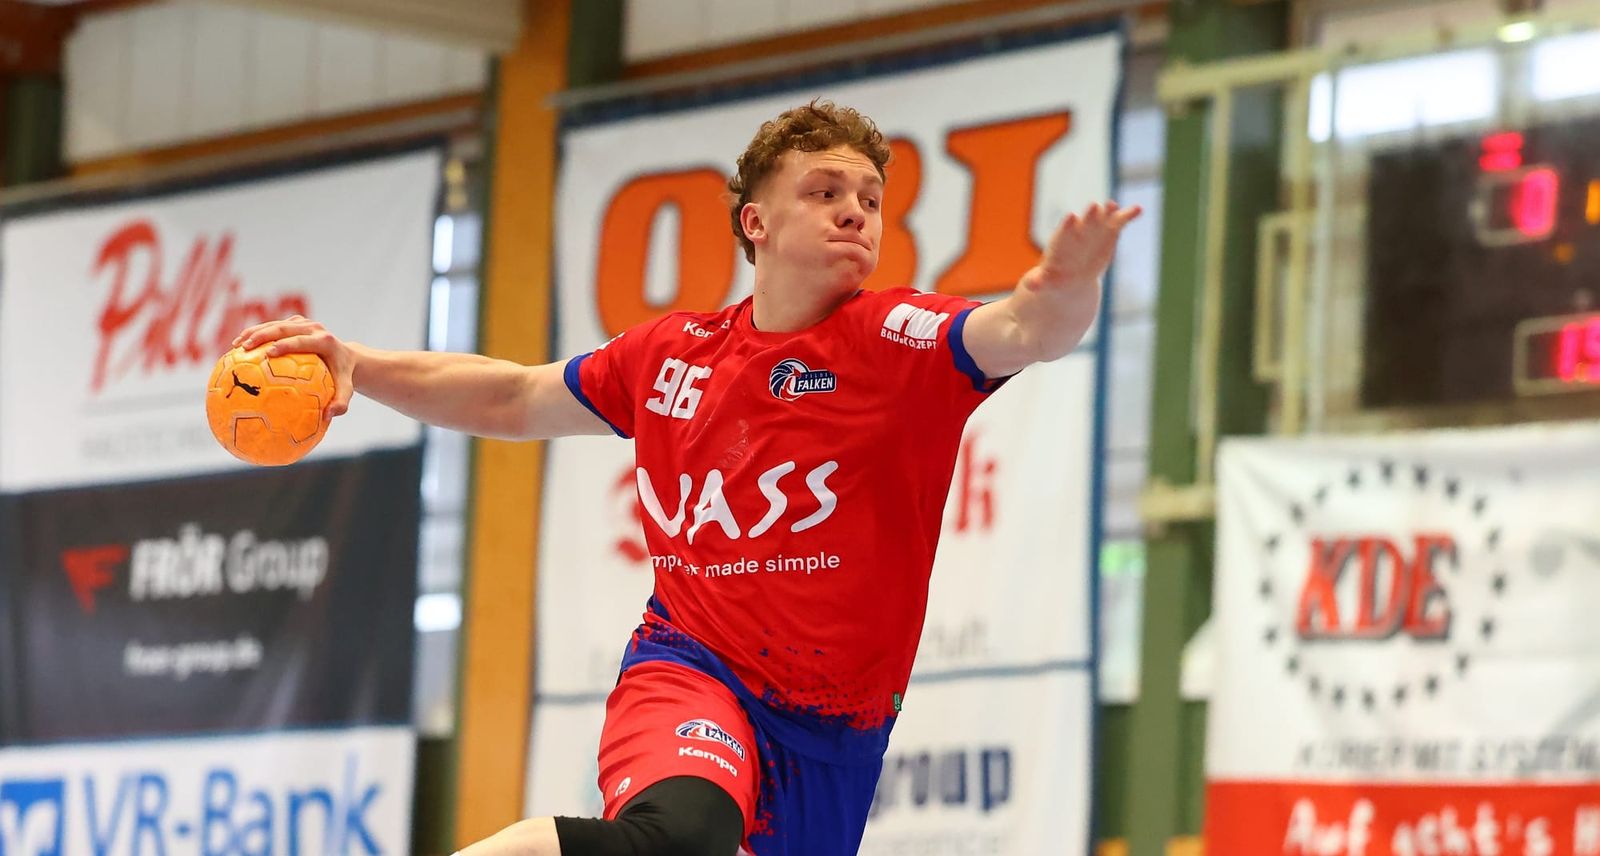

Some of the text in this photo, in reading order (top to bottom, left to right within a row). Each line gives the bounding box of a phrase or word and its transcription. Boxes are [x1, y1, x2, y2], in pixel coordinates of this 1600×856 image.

[645, 357, 713, 420] 96
[797, 377, 833, 391] FALKEN
[225, 529, 329, 601] Group
[705, 557, 759, 577] made
[765, 551, 840, 574] simple
[1295, 530, 1459, 641] KDE
[678, 746, 738, 777] Kempa
[83, 752, 384, 856] VR-Bank
